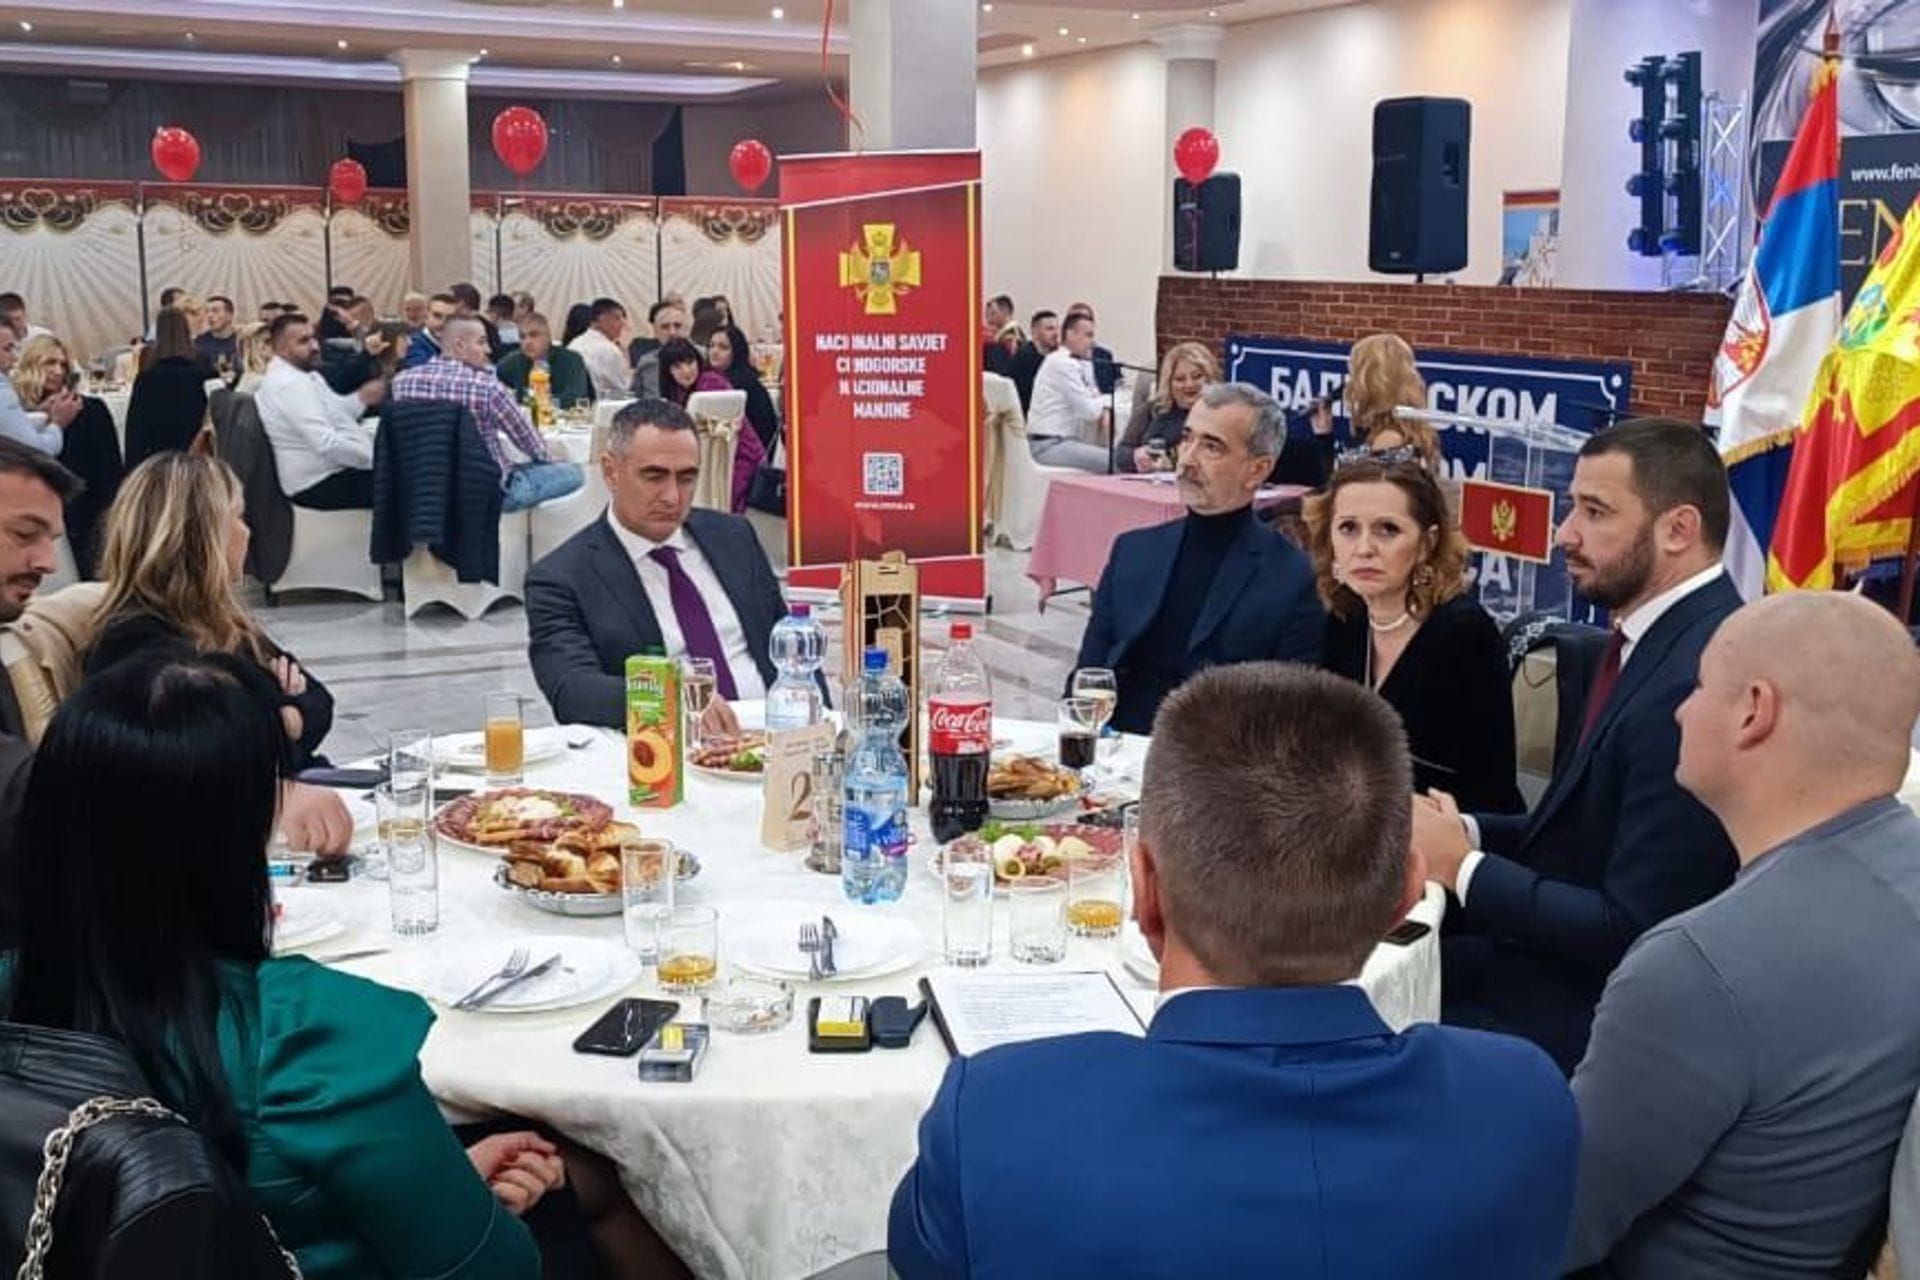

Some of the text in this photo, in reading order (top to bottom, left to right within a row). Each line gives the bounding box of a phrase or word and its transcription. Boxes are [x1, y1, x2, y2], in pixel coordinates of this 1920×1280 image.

[898, 333, 947, 350] SAVJET
[853, 401, 912, 419] MANJINE
[1270, 366, 1558, 434] БАЛСКОМ
[788, 771, 812, 821] 2
